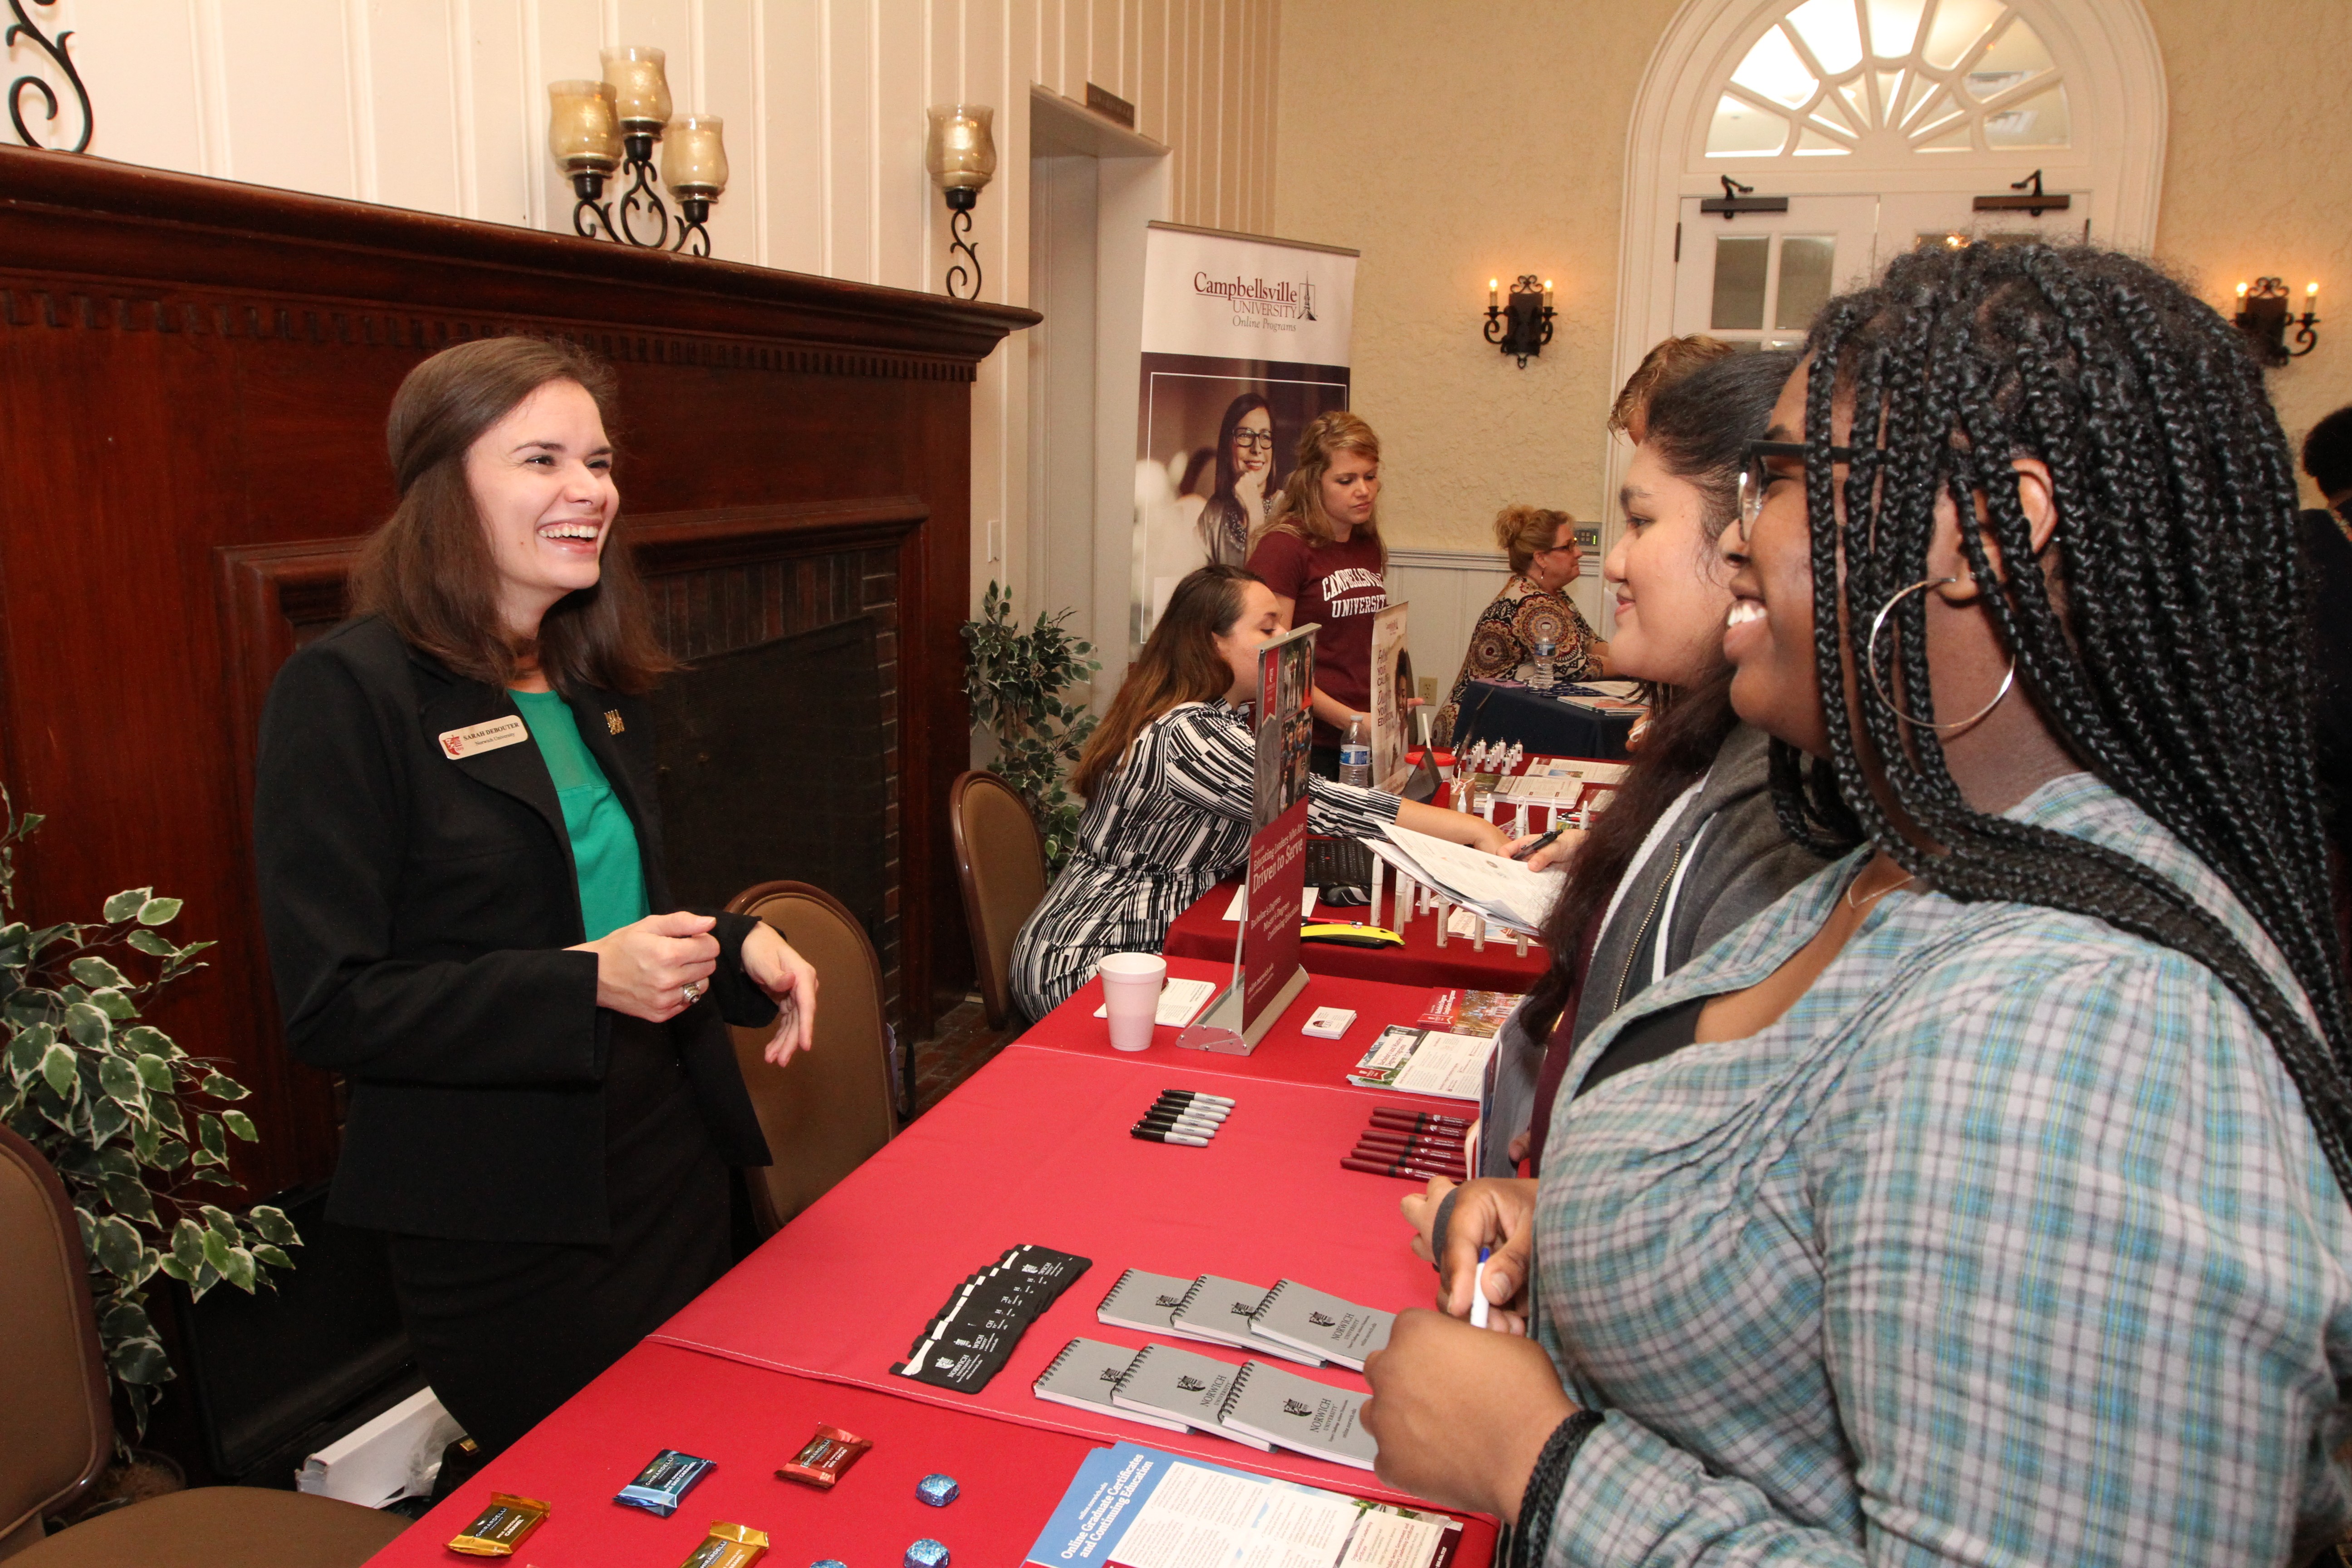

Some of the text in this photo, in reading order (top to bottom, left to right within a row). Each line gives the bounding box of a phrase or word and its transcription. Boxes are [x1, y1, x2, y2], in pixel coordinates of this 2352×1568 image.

[1194, 272, 1297, 302] Campbellsville
[1233, 300, 1297, 318] UNIVERSITY
[1233, 315, 1296, 333] Online Programs
[1332, 594, 1387, 618] UNIVERSIT
[463, 722, 519, 741] SARAH DEBOUTER
[475, 732, 515, 746] Norwich University
[1253, 862, 1276, 894] Driven
[1277, 854, 1284, 871] to
[1285, 838, 1303, 864] Serve
[1254, 848, 1274, 872] Educating
[1331, 1313, 1354, 1341] NORWICH
[947, 1354, 970, 1378] NORWICH
[1200, 1375, 1227, 1407] NORWICH
[1309, 1398, 1332, 1433] NORWICH
[1323, 1405, 1338, 1431] UNIVERSITY
[804, 1440, 830, 1466] GHIRARDELLI
[835, 1449, 848, 1460] CACAO
[645, 1457, 674, 1486] GHIRARDELLI
[679, 1461, 697, 1478] CARAMEL
[1061, 1453, 1144, 1559] Online Graduate Certificates
[1080, 1461, 1154, 1558] and Continuing Education
[475, 1508, 507, 1537] GHIRARDELLI
[505, 1519, 524, 1537] CARAMEL
[700, 1541, 728, 1568] HIRARDELLI
